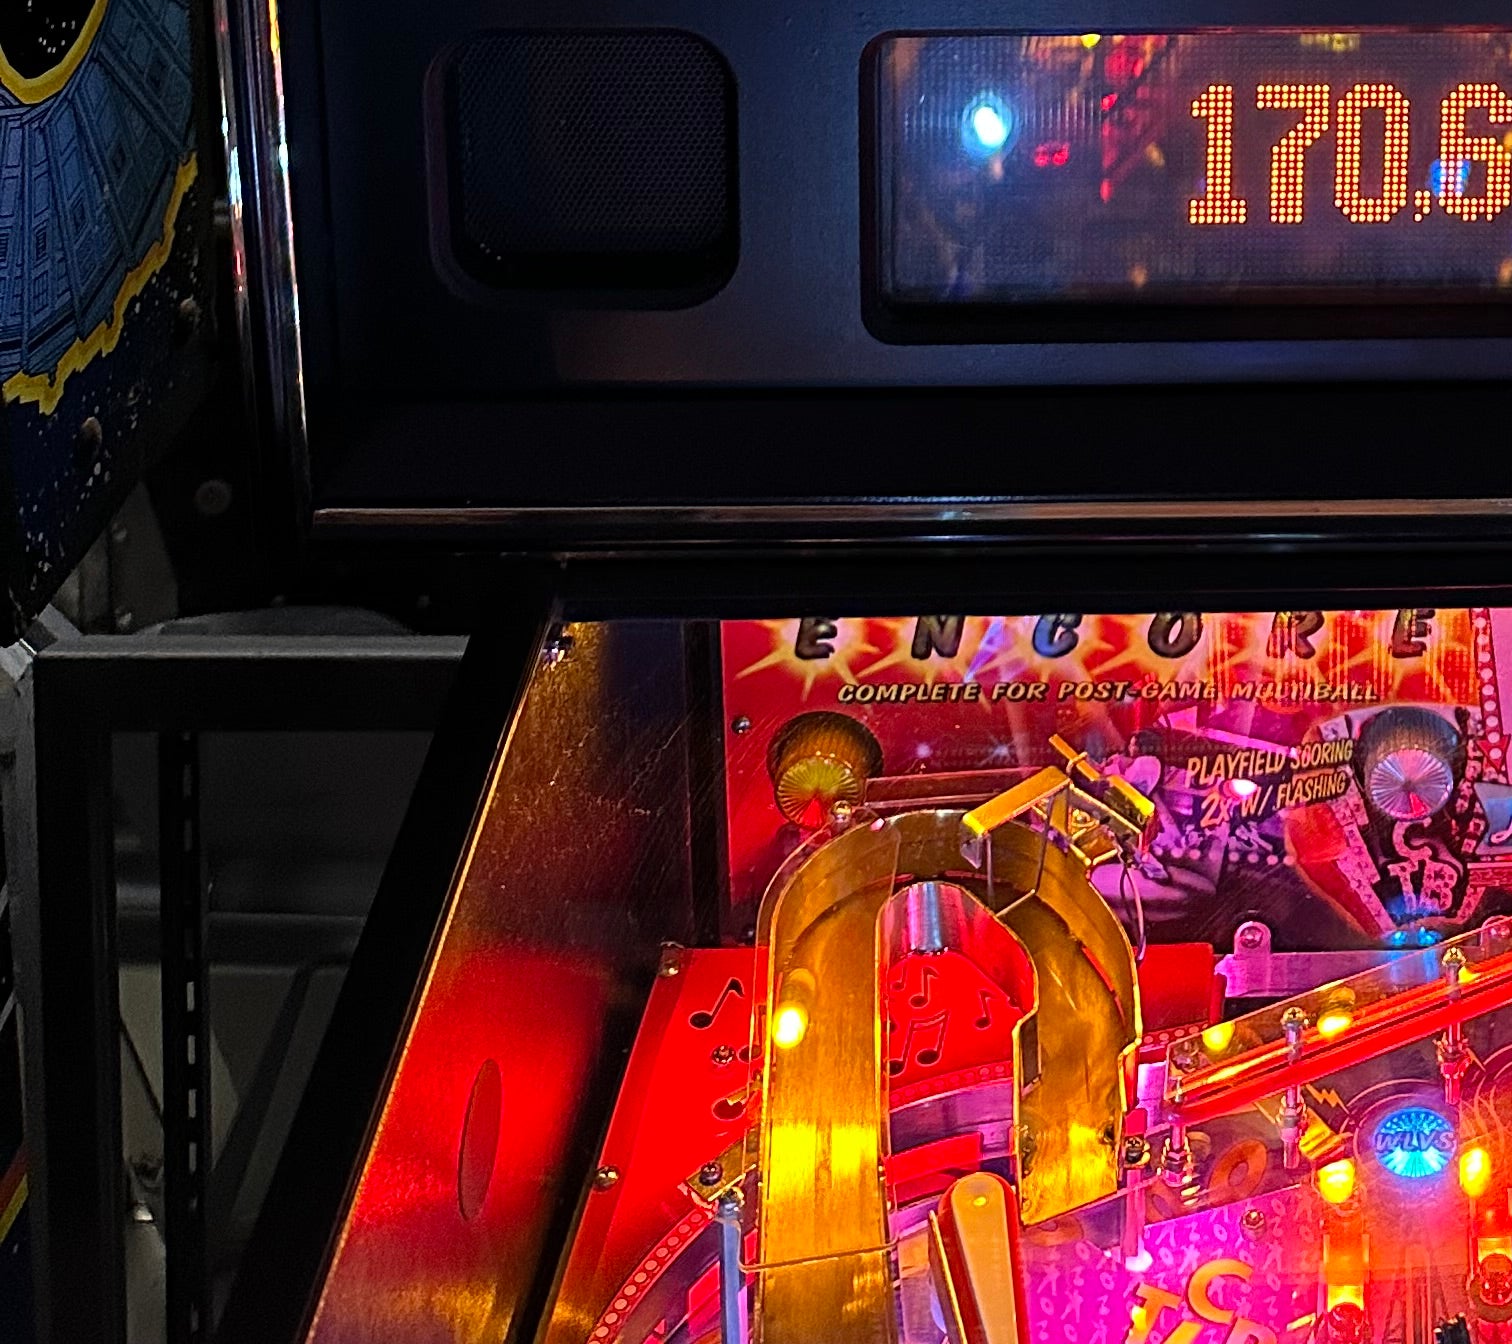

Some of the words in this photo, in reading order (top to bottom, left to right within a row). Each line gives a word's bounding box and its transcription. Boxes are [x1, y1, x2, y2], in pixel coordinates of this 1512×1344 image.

[793, 608, 1438, 659] ENCORE
[837, 683, 981, 704] COMPLETE
[991, 682, 1046, 701] FOR
[1057, 680, 1217, 701] POST-GAME
[1184, 750, 1286, 788] PLAYFIELD
[1275, 771, 1347, 811] FLASHING
[1374, 1130, 1456, 1153] WLVS
